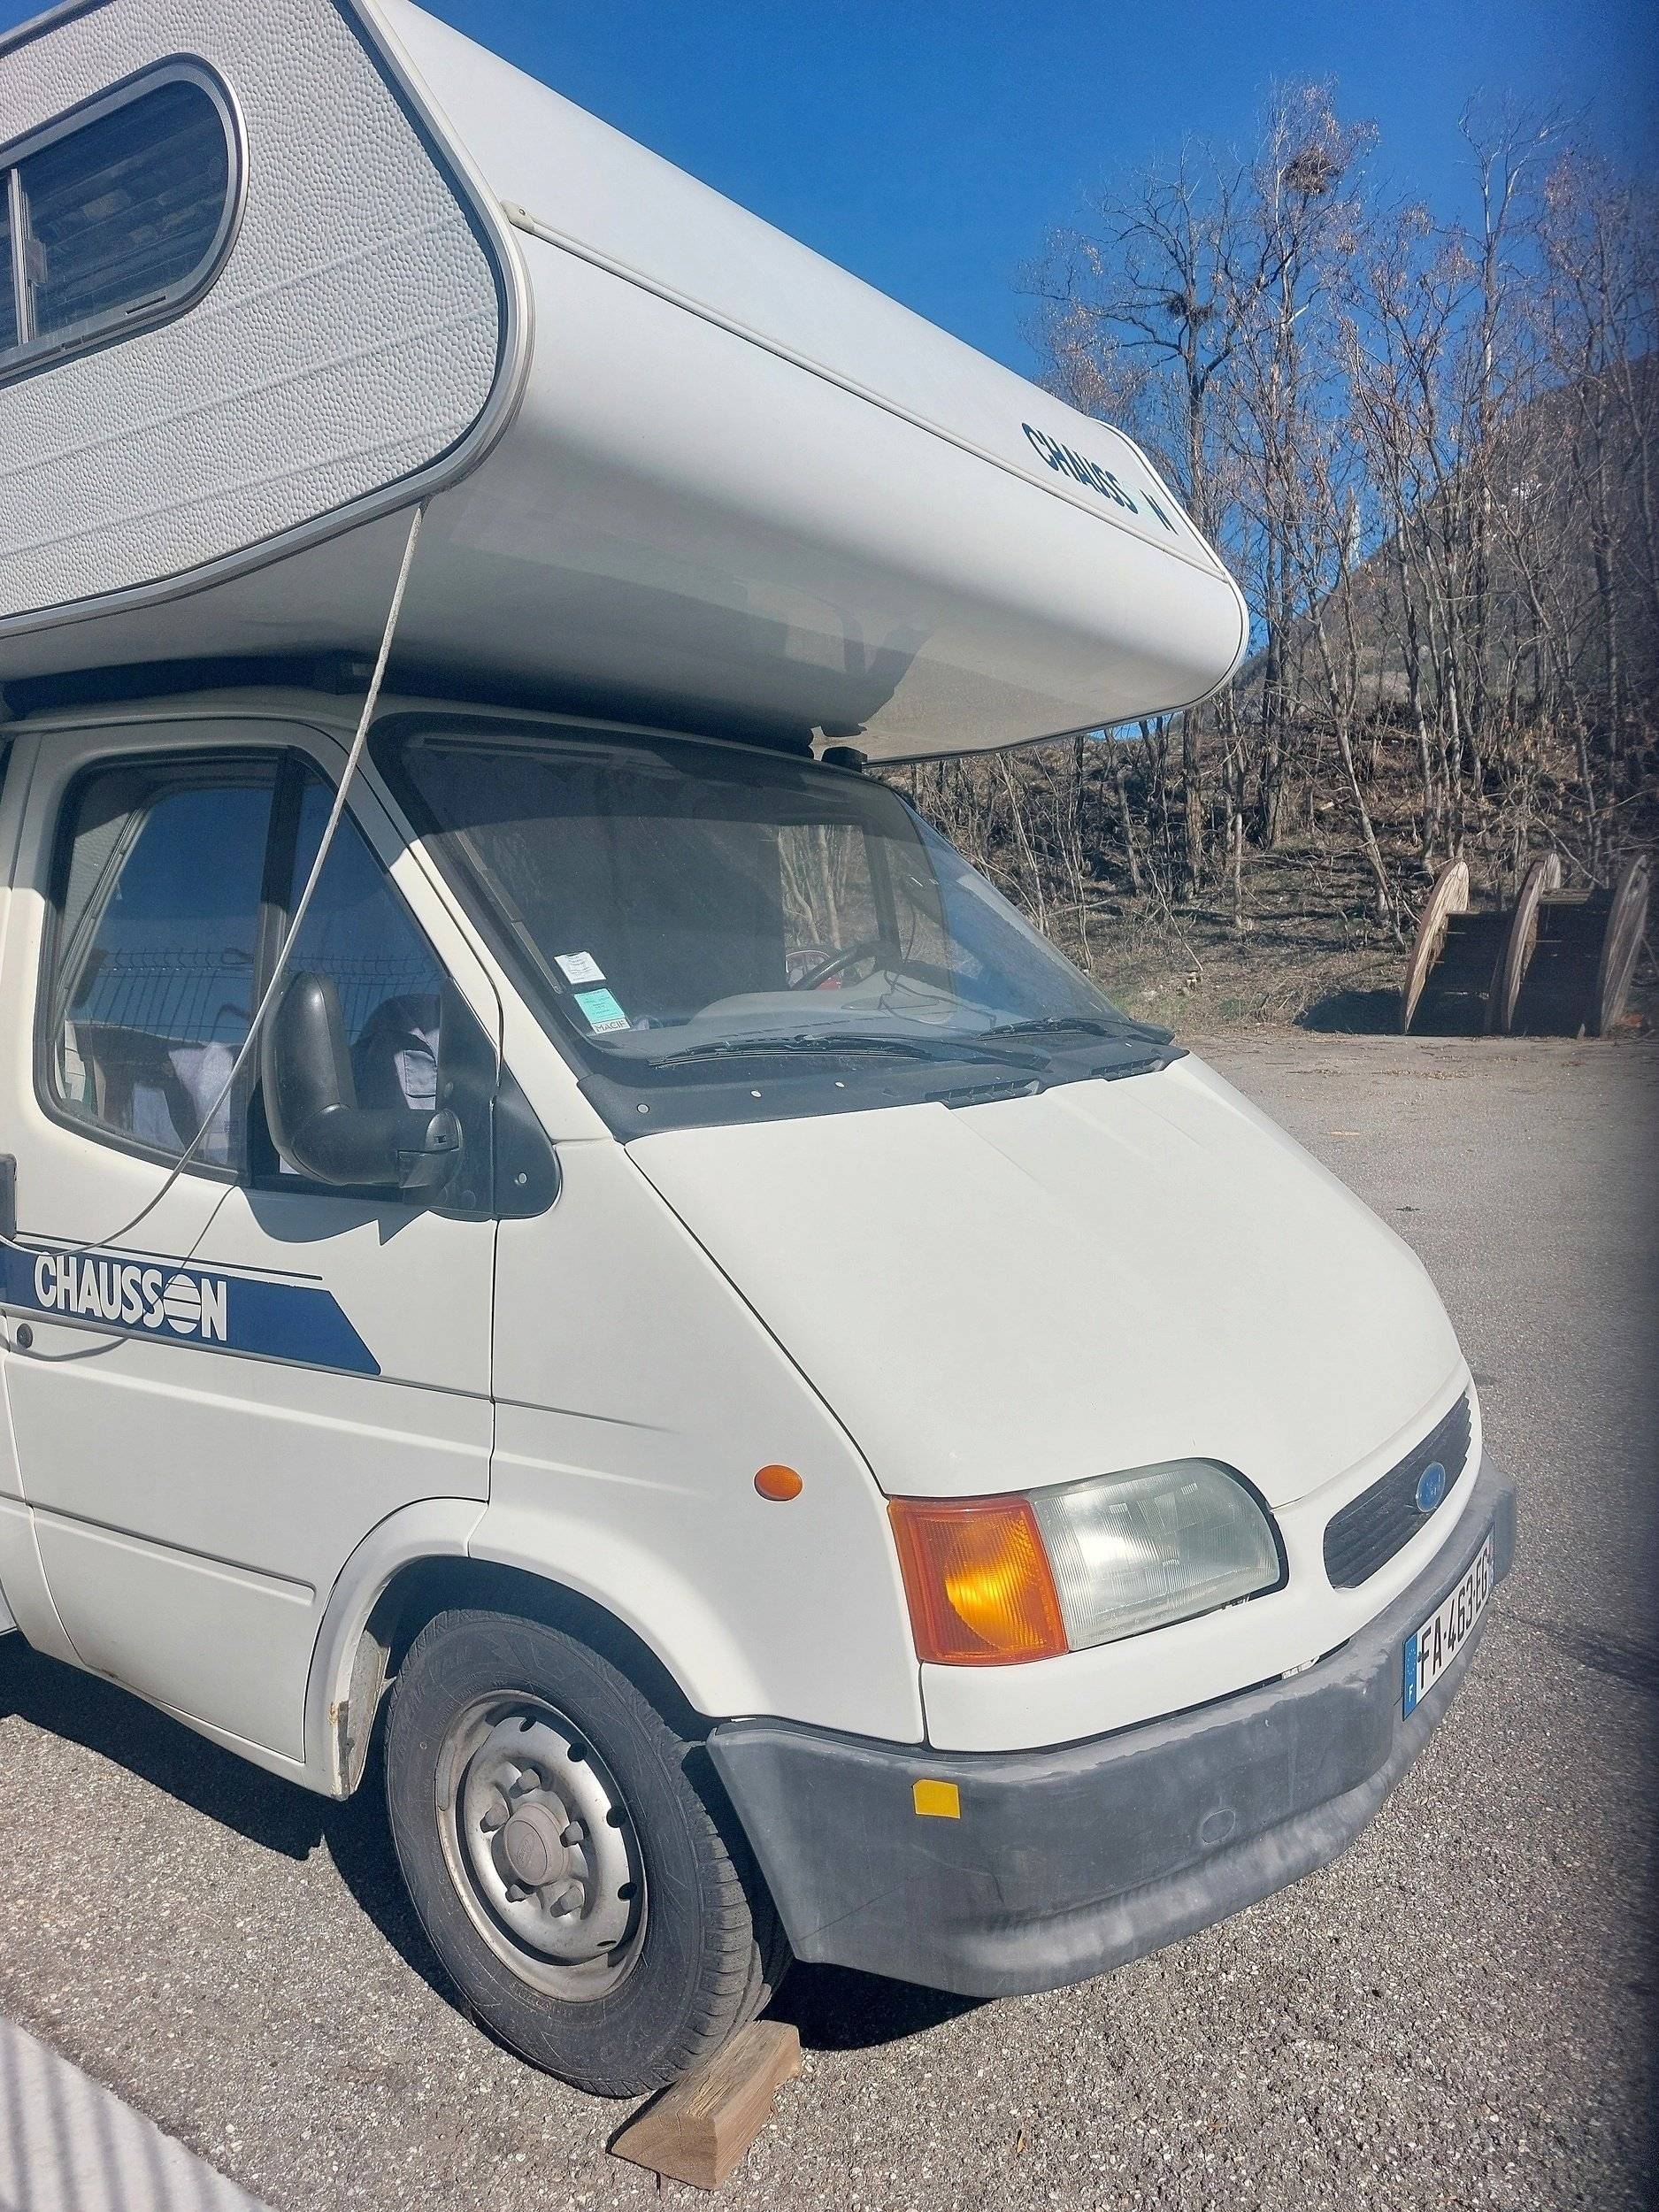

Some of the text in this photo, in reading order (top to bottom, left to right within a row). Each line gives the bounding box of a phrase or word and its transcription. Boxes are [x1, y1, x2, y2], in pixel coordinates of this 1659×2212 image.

[1022, 422, 1179, 536] CHAUSSN
[595, 1019, 626, 1032] MACIF
[34, 1253, 227, 1341] CHAUSSON
[1409, 1684, 1414, 1702] F
